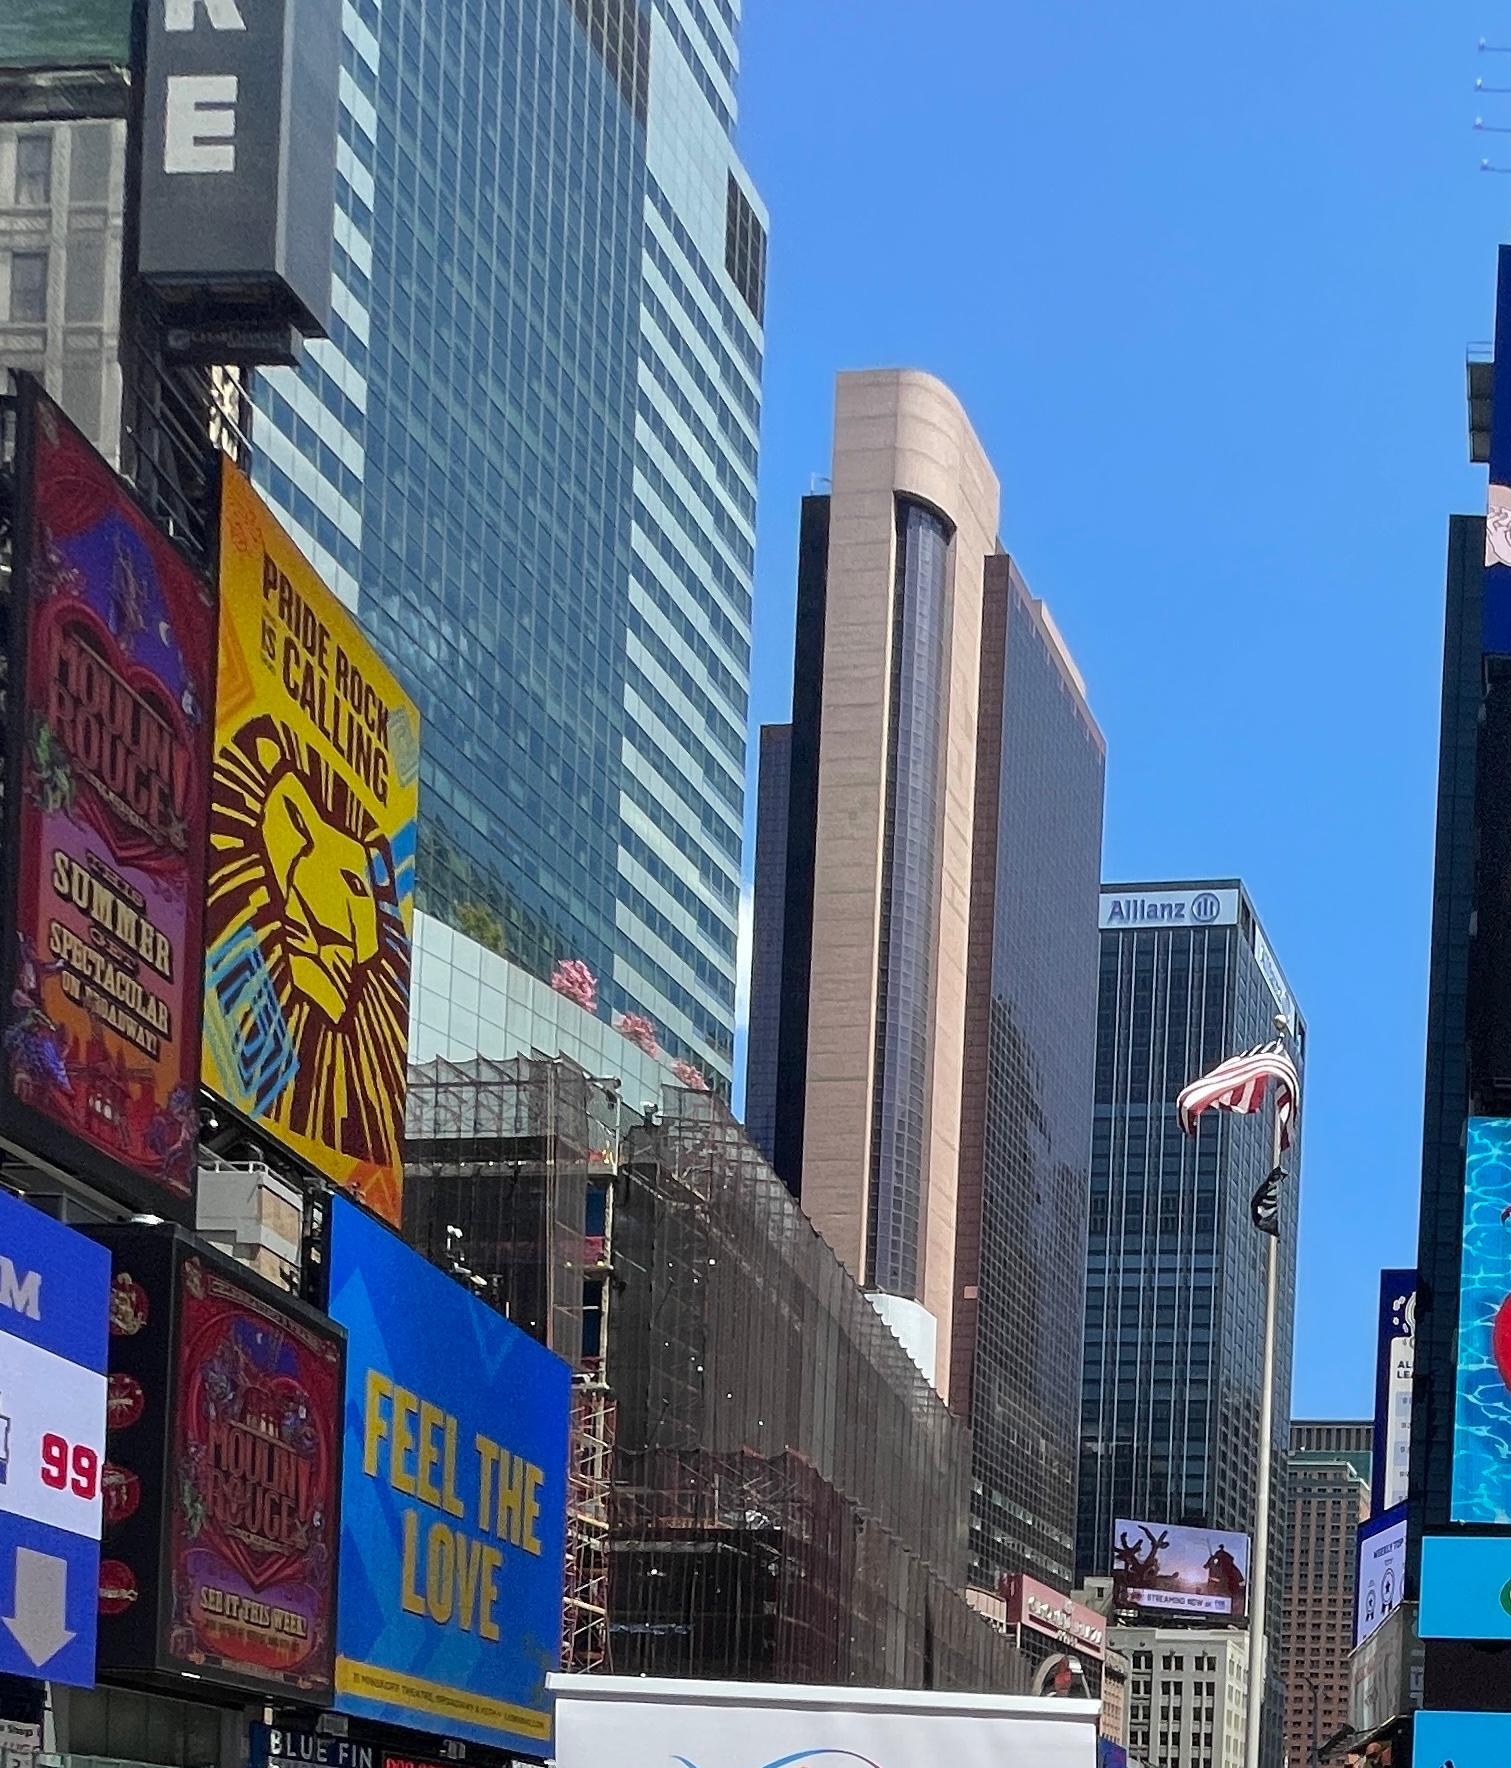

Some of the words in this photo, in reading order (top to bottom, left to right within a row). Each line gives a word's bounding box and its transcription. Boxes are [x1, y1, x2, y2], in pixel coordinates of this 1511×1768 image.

[262, 553, 332, 680] PRIDE
[335, 645, 390, 753] ROCK
[282, 636, 389, 808] CALLING
[52, 851, 172, 980] SUMMER
[1107, 900, 1186, 924] Allianz
[50, 921, 171, 1038] SPECTACULAR
[42, 1433, 98, 1500] 99
[362, 1367, 465, 1519] FEEL
[474, 1431, 545, 1557] THE
[402, 1508, 504, 1641] LOVE
[269, 1728, 329, 1763] BLUE
[338, 1742, 373, 1768] FIN
